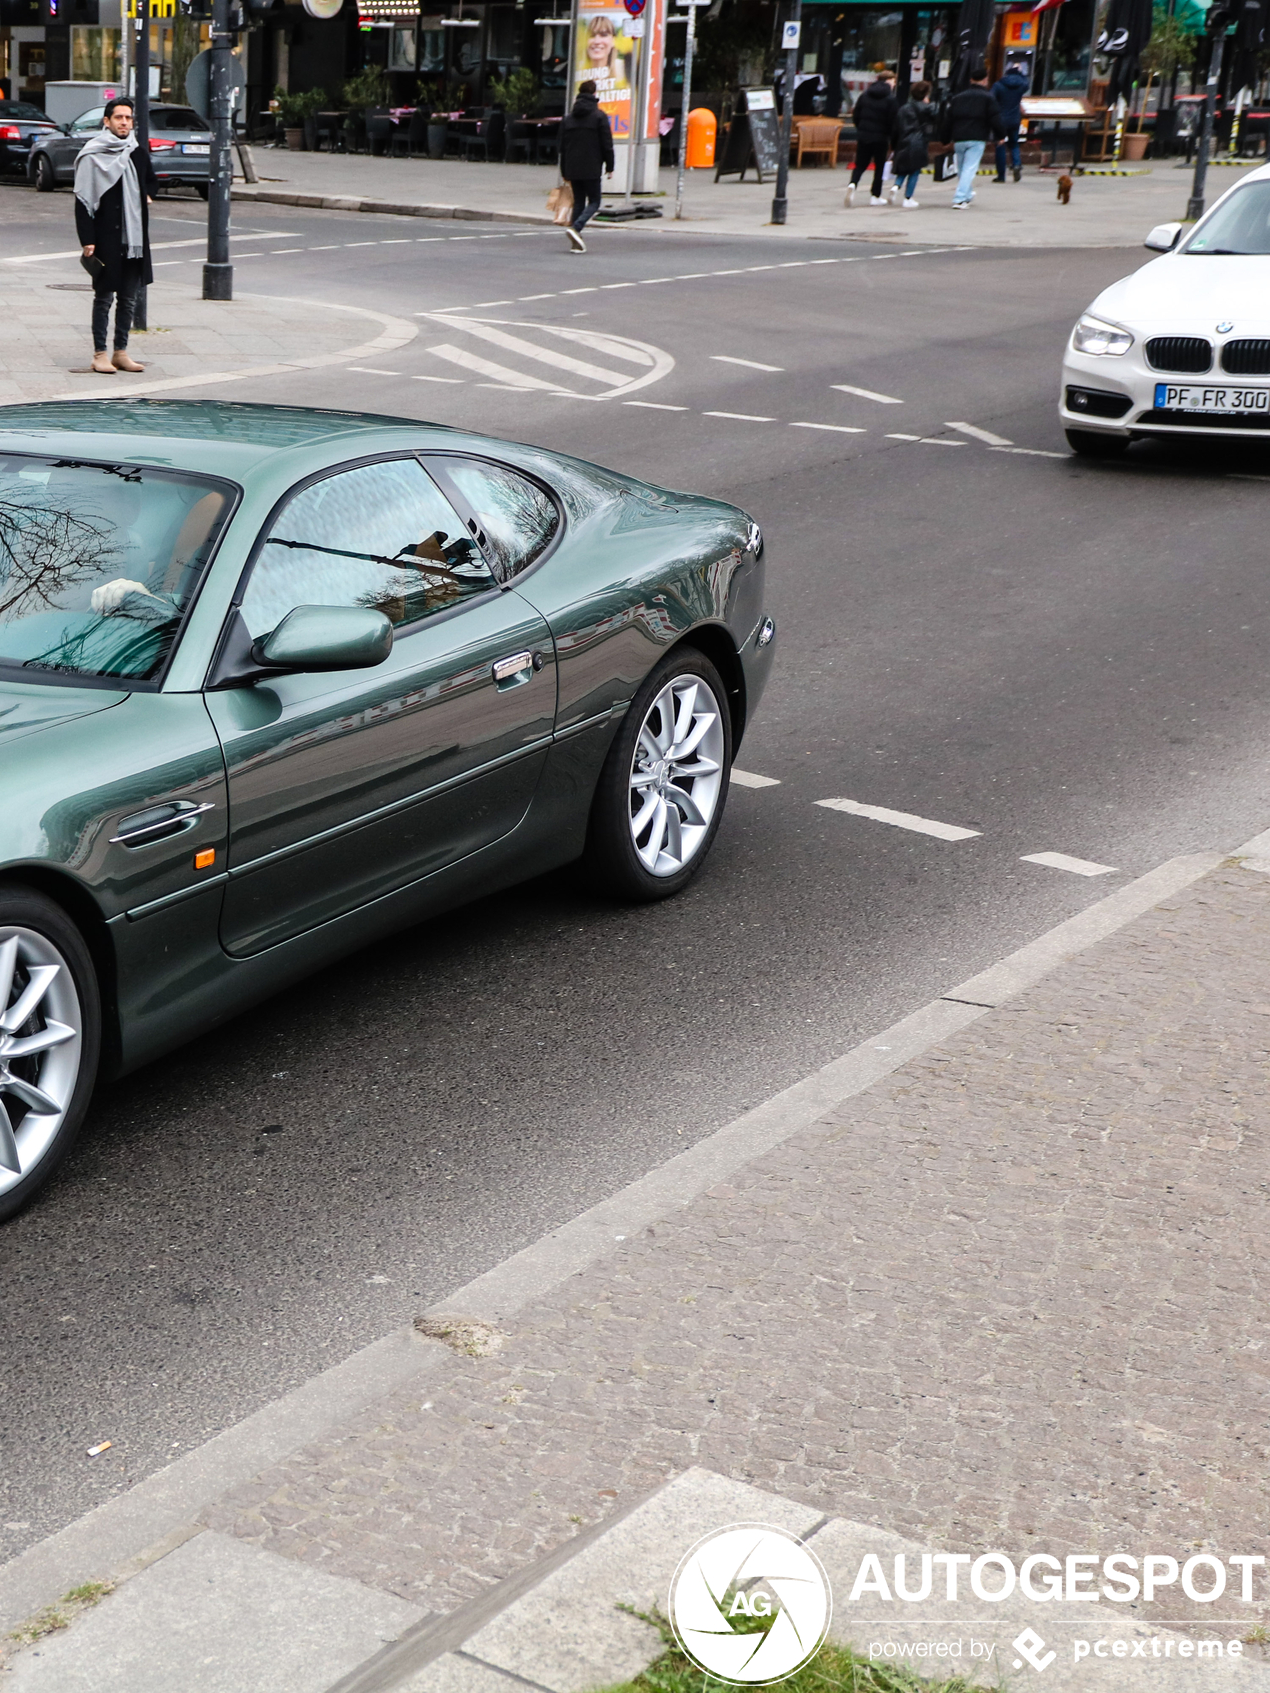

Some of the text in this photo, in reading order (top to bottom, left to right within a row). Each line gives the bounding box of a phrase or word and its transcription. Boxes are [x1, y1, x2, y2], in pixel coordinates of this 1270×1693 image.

[595, 78, 616, 91] RKT
[1167, 388, 1190, 405] PF
[1202, 390, 1226, 407] FR
[1231, 391, 1267, 408] 300
